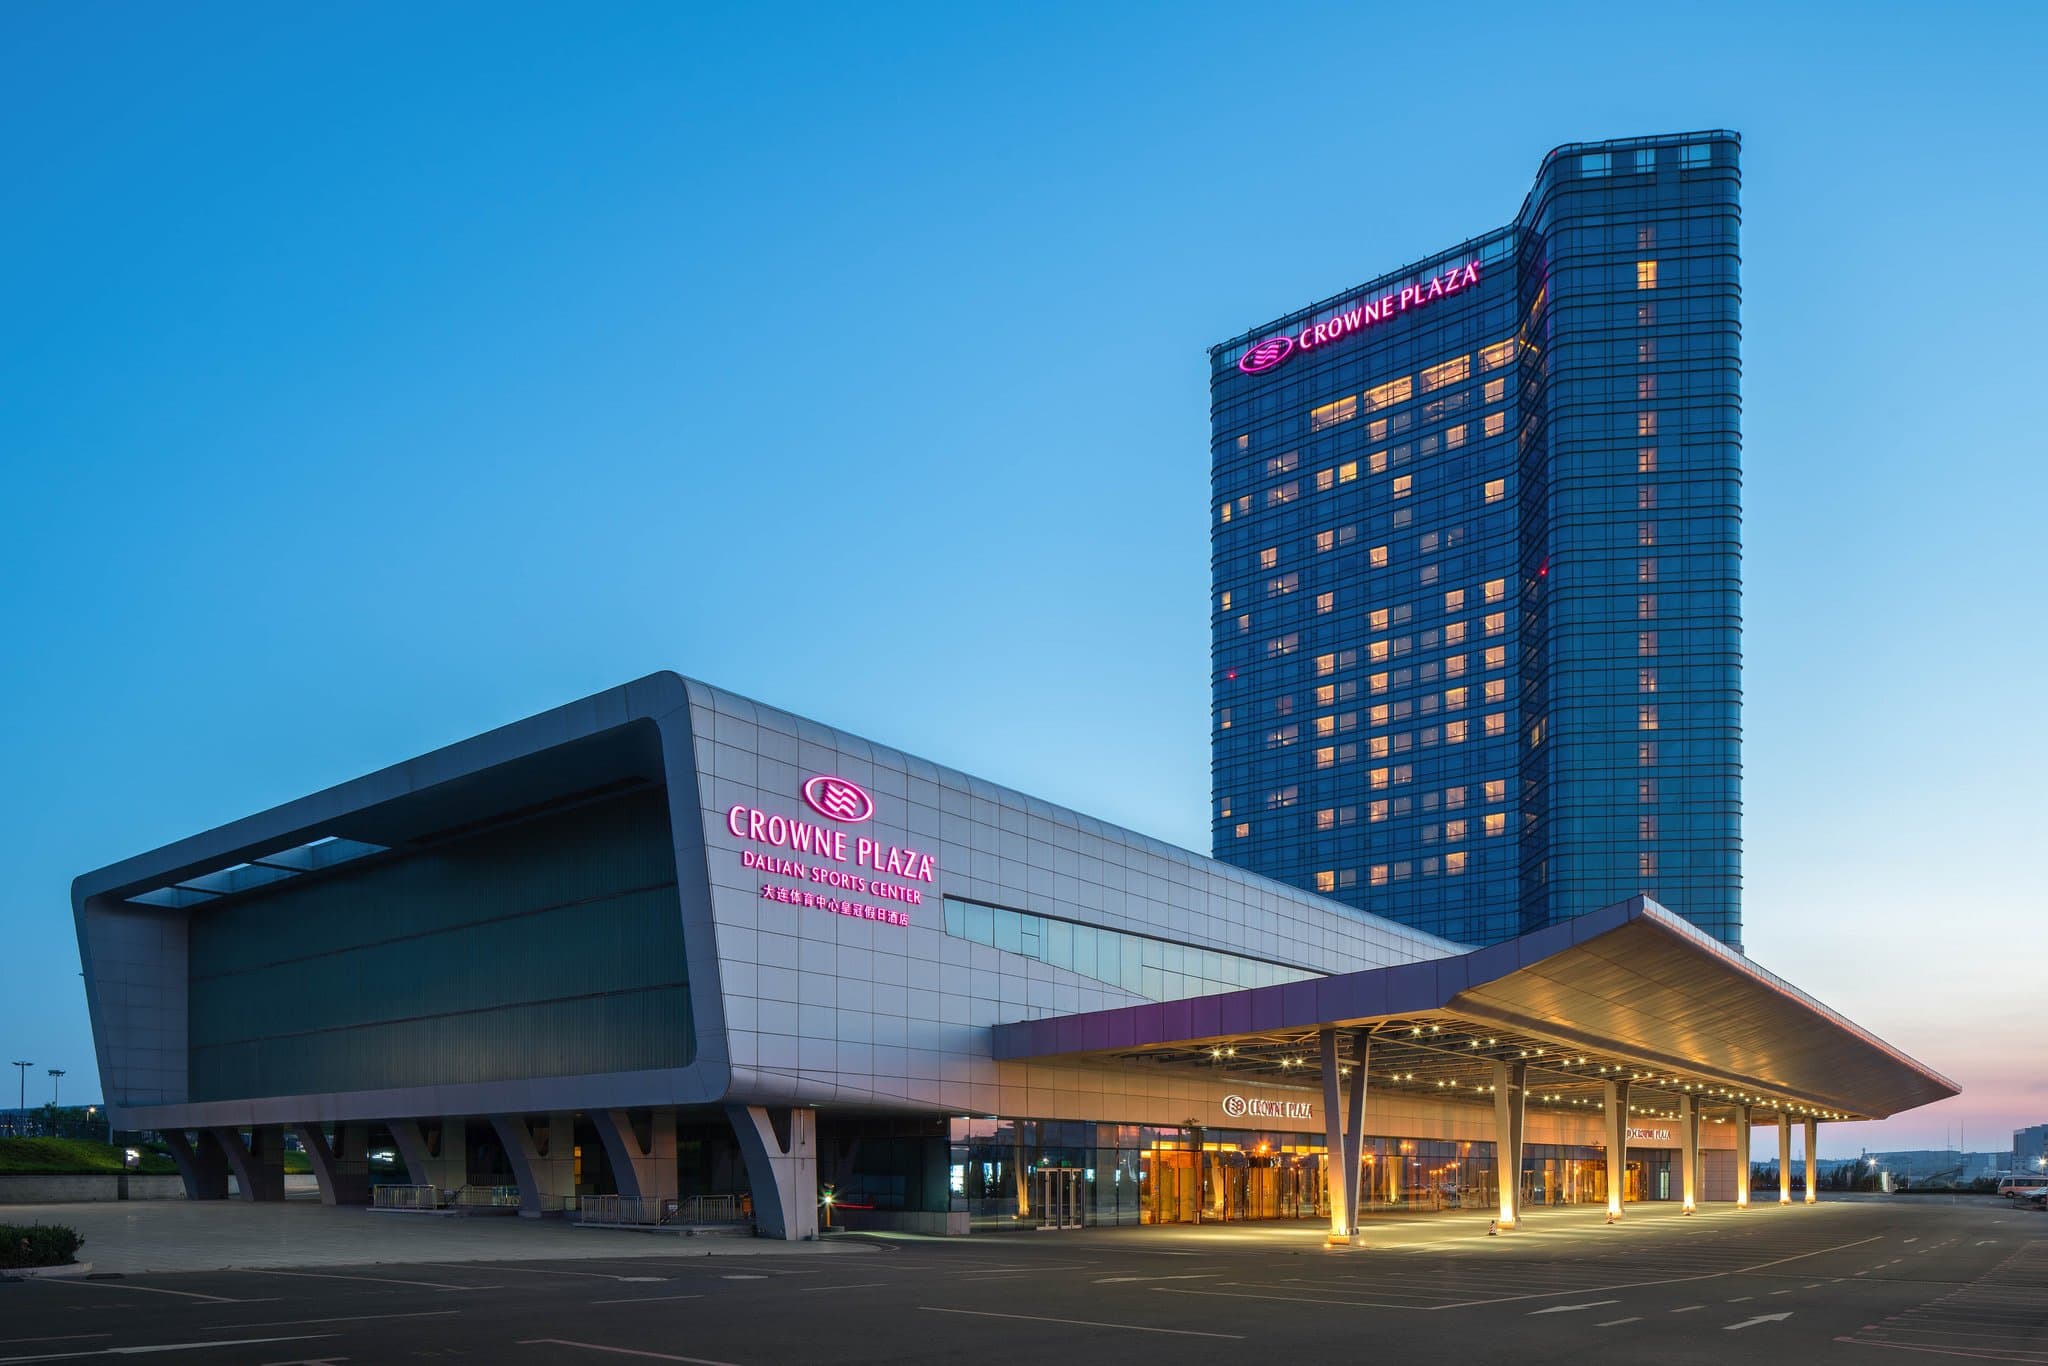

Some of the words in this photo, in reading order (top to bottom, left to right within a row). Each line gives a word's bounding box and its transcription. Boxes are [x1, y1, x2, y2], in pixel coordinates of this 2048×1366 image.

[1299, 295, 1394, 349] CROWNE
[1401, 260, 1480, 310] PLAZA
[728, 805, 847, 861] CROWNE
[857, 837, 935, 882] PLAZA
[742, 850, 805, 878] DALIAN
[811, 866, 865, 892] SPORTS
[870, 880, 921, 904] CENTER
[761, 883, 909, 926] 大连体育中心皇冠假日酒店
